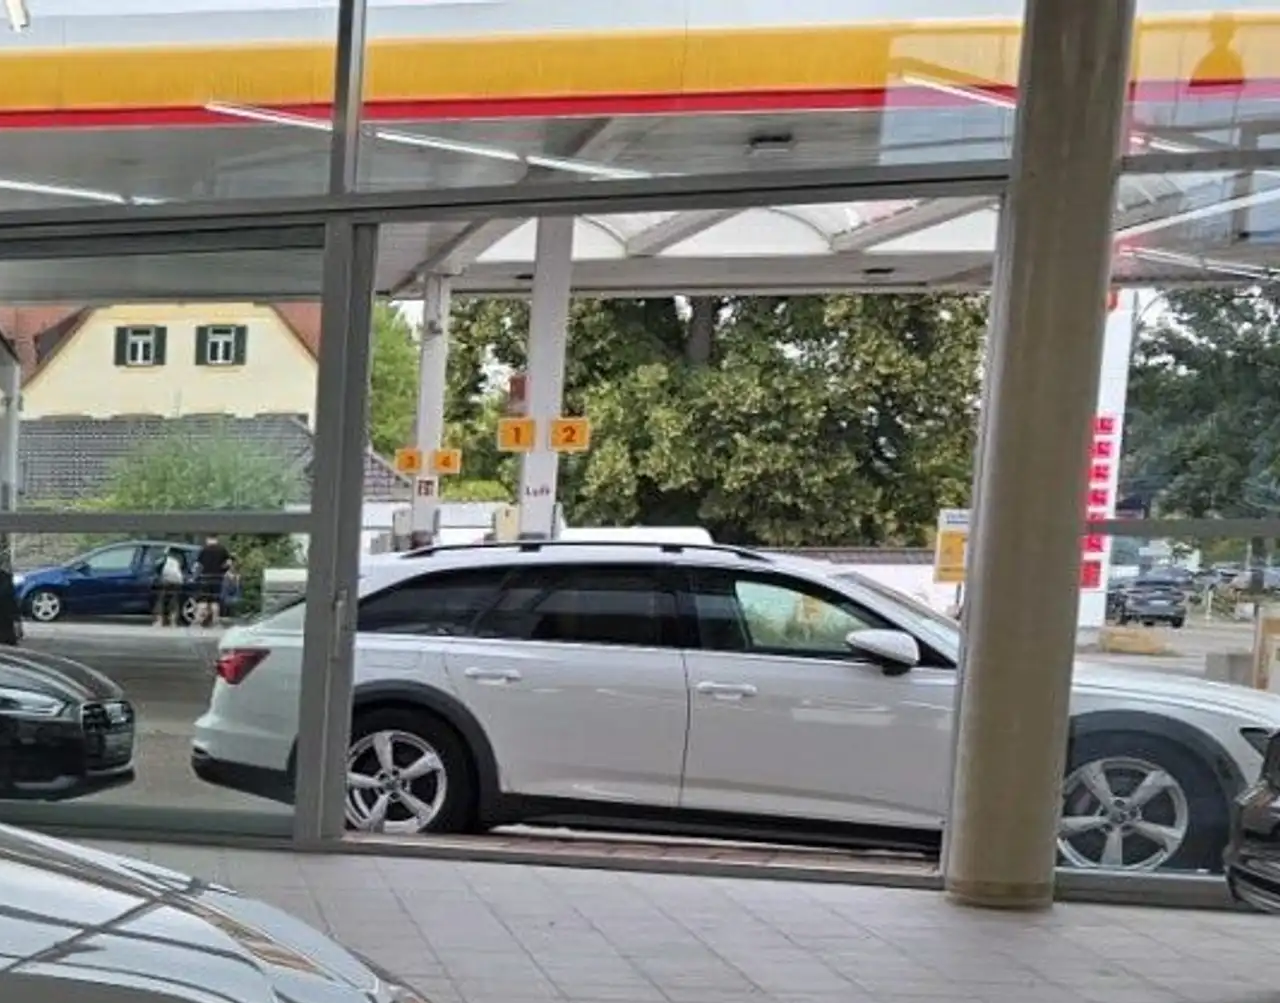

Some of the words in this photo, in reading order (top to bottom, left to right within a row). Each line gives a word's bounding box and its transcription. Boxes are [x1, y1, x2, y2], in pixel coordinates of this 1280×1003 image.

[512, 426, 521, 444] 1
[561, 426, 576, 444] 2
[406, 455, 416, 467] 3
